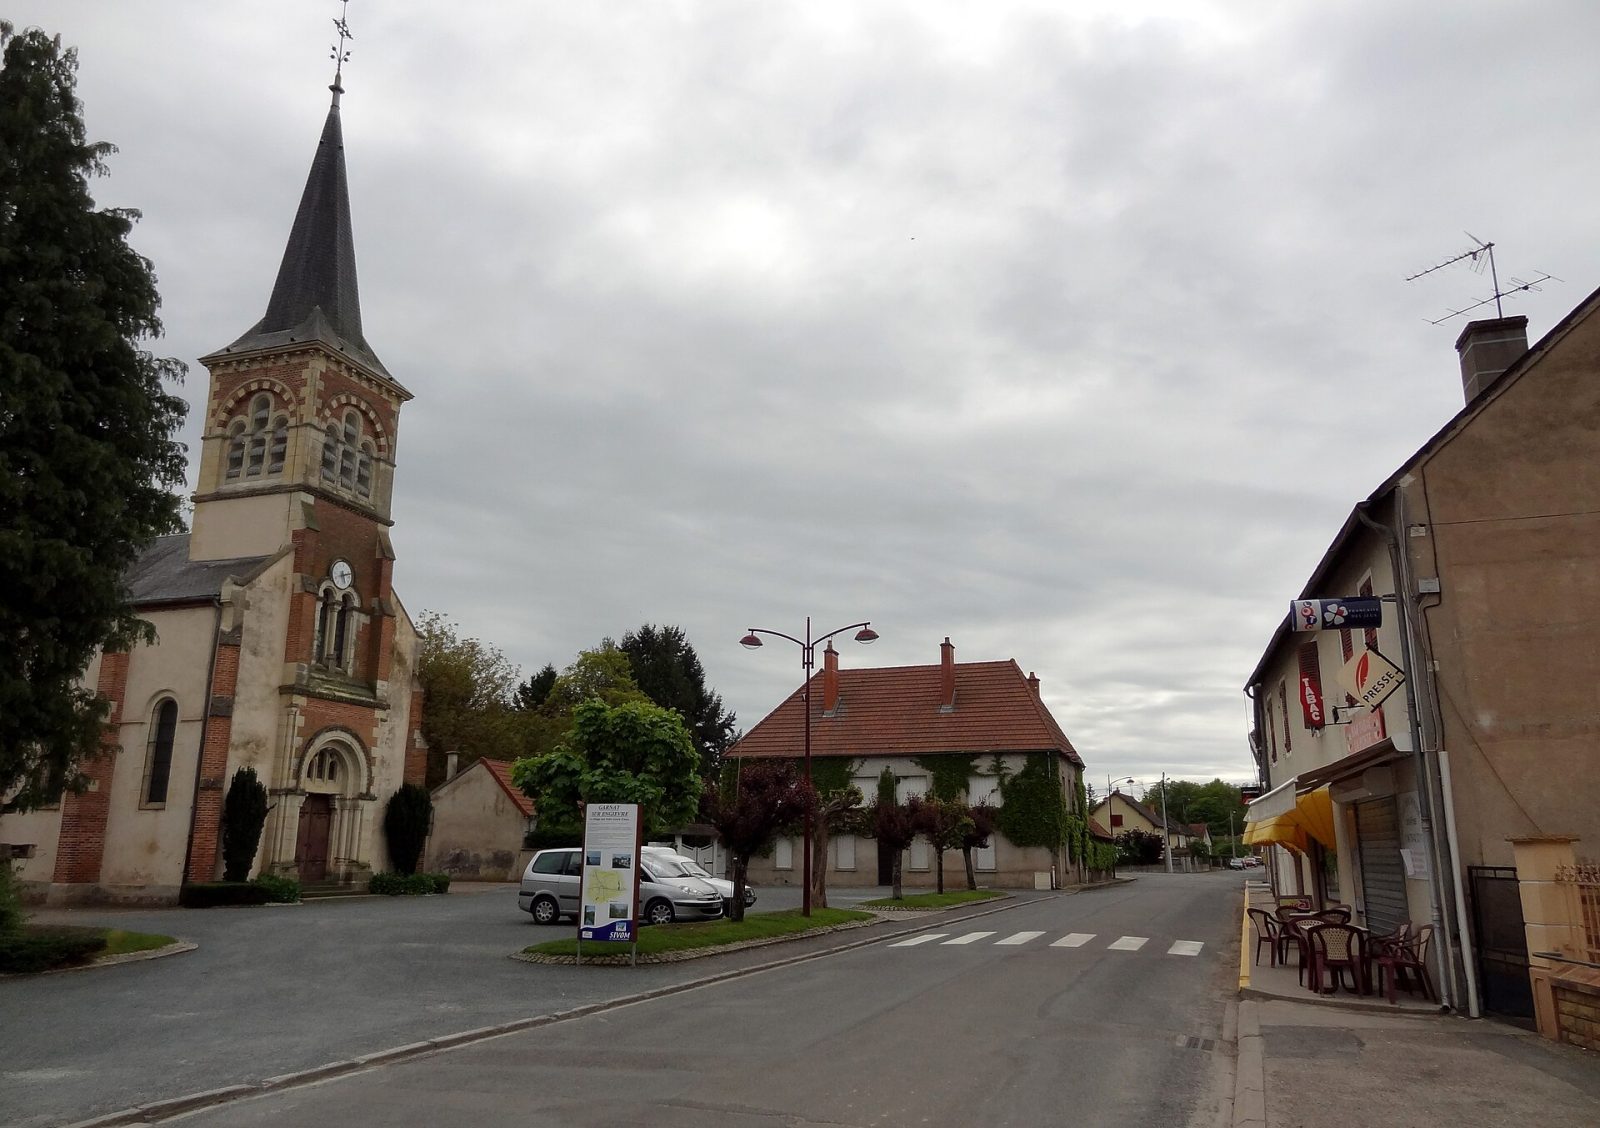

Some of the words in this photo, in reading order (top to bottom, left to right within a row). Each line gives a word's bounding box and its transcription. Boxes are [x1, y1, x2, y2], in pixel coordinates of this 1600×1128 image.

[1302, 601, 1317, 629] LOTO
[1302, 677, 1321, 721] TABAC
[1362, 671, 1395, 703] PRESSE
[609, 931, 631, 939] SIVOM
